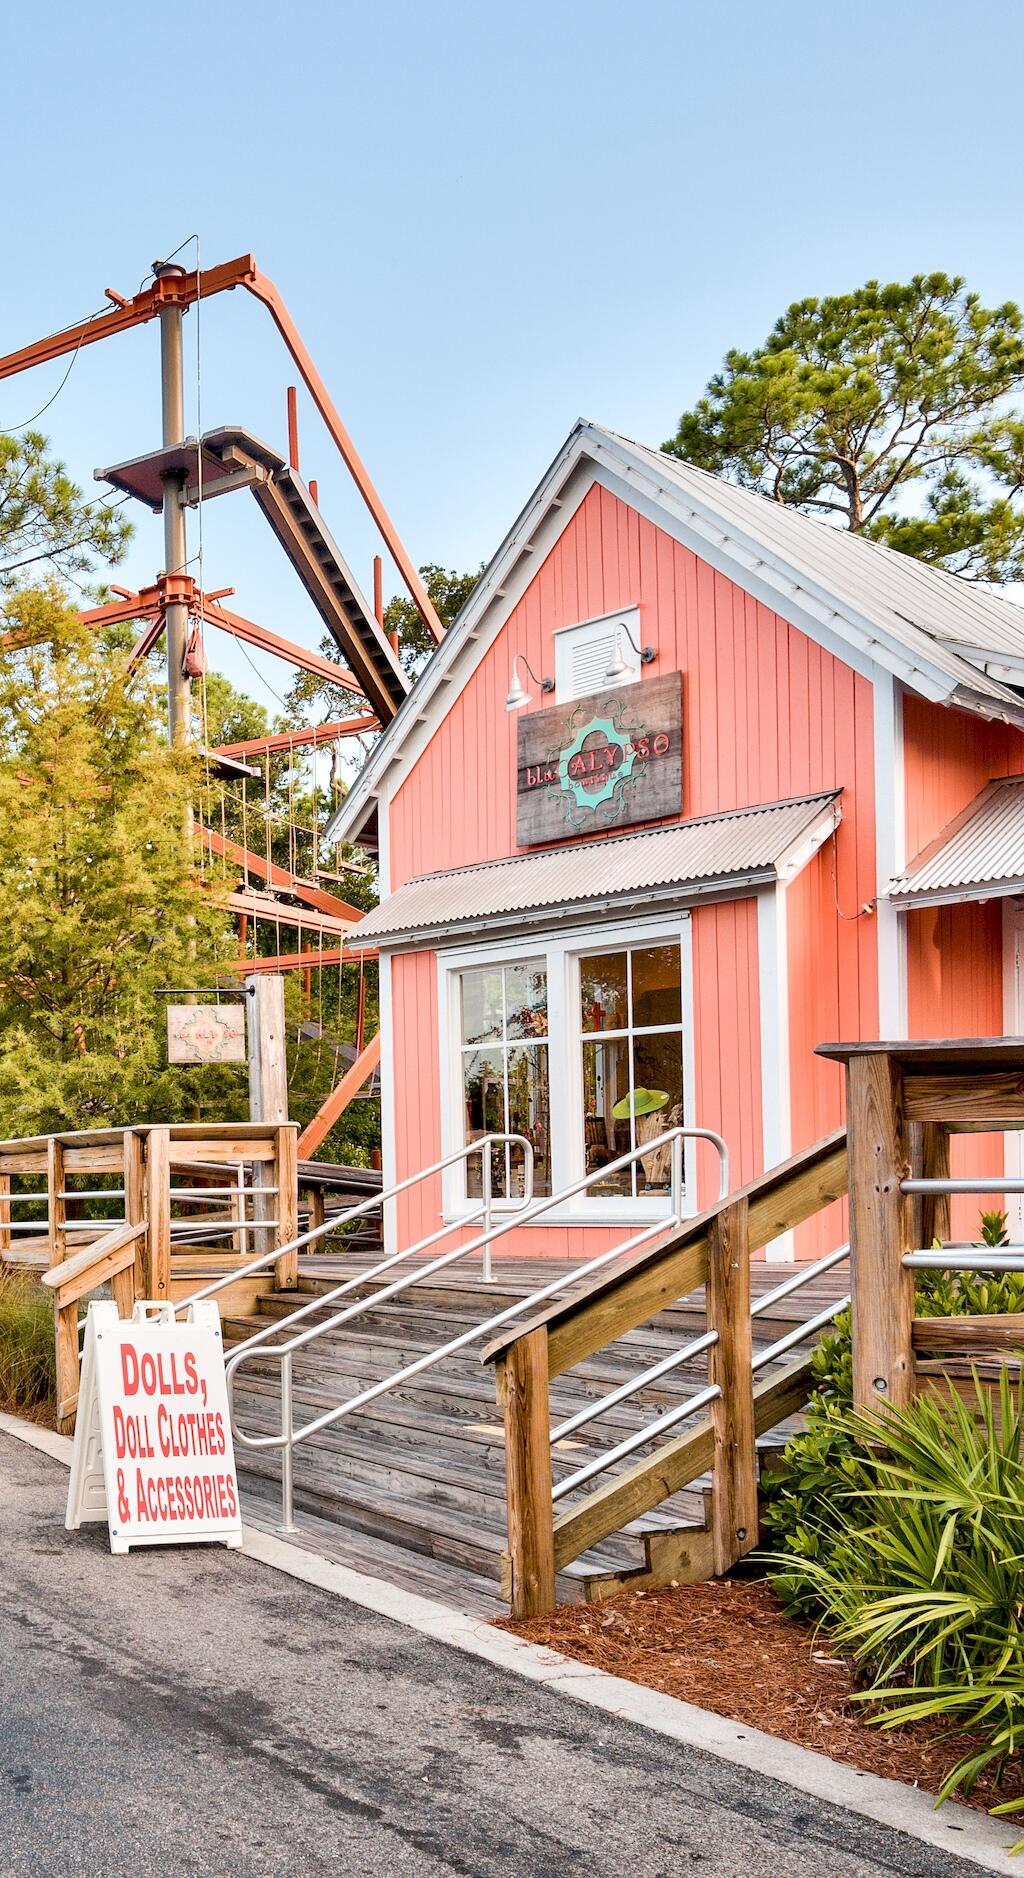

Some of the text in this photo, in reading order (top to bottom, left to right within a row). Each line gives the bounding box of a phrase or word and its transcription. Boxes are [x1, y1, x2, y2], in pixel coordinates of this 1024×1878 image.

[120, 1343, 208, 1407] DOLLS,
[112, 1403, 226, 1459] DOLL CLOTHES
[116, 1467, 237, 1524] & ACCESSORIES
